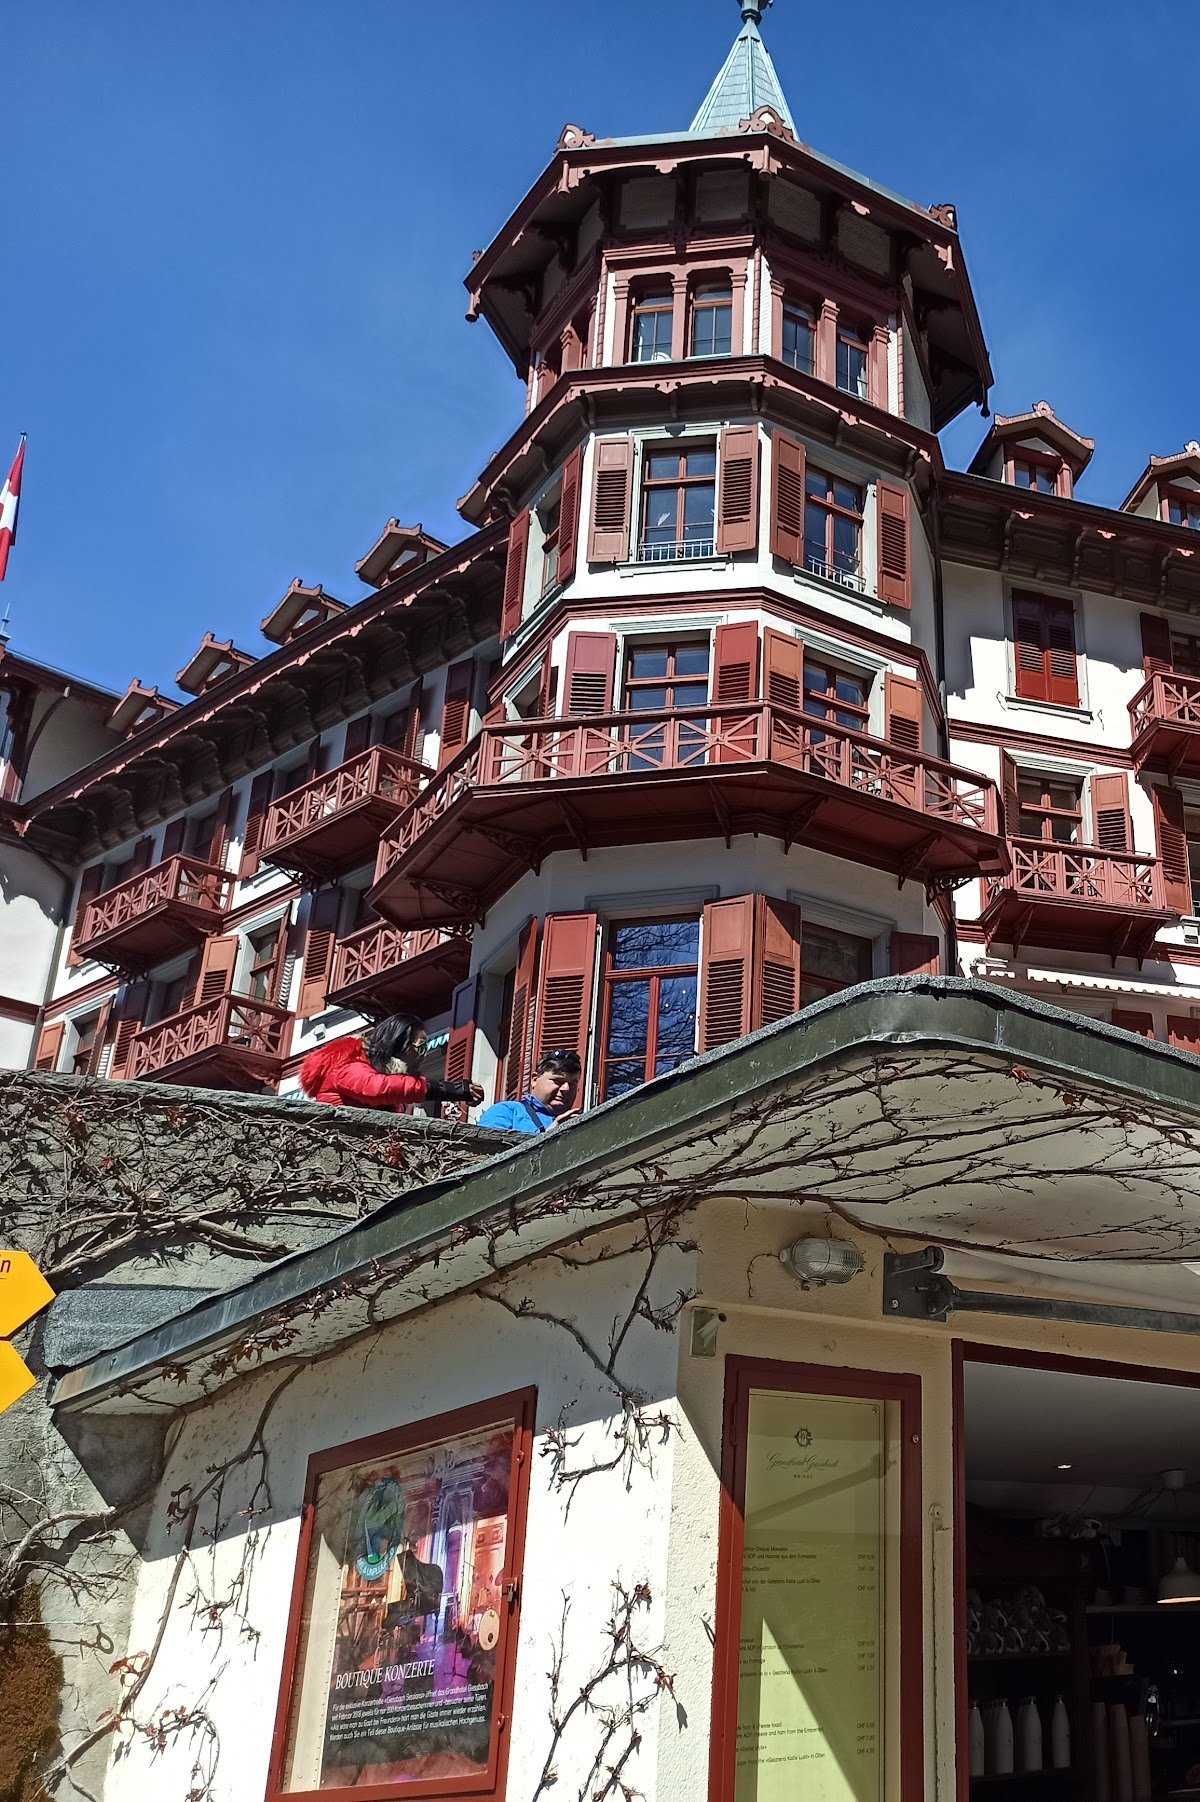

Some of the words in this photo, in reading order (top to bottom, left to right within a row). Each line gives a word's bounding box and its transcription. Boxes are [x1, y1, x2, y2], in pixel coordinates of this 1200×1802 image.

[335, 1667, 383, 1690] BOUTIQUE
[384, 1659, 436, 1682] KONZERTE
[375, 1727, 387, 1736] dieser
